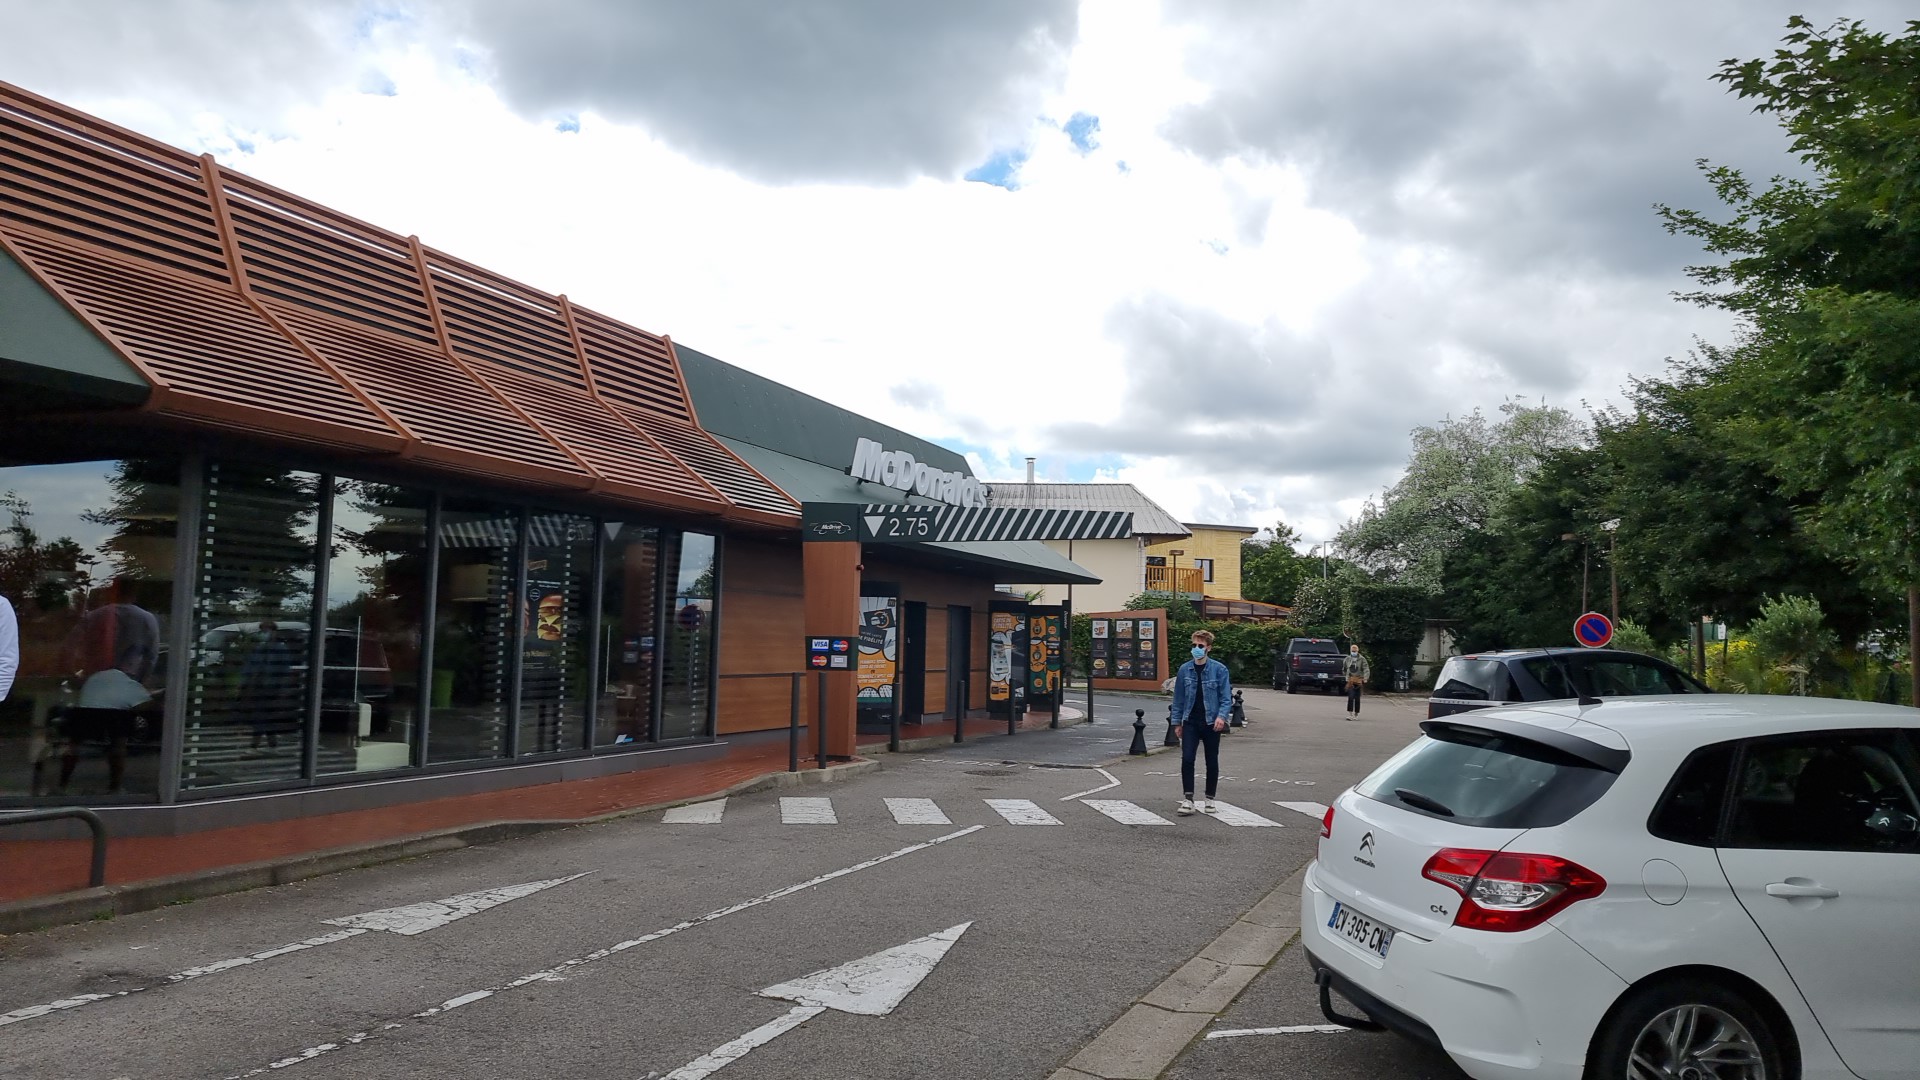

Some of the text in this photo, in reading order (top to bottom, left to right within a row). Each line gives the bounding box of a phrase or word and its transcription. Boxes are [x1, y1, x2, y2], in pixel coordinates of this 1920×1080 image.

[851, 437, 988, 508] McDonald's
[889, 517, 928, 536] 2.75
[1430, 904, 1449, 917] C4
